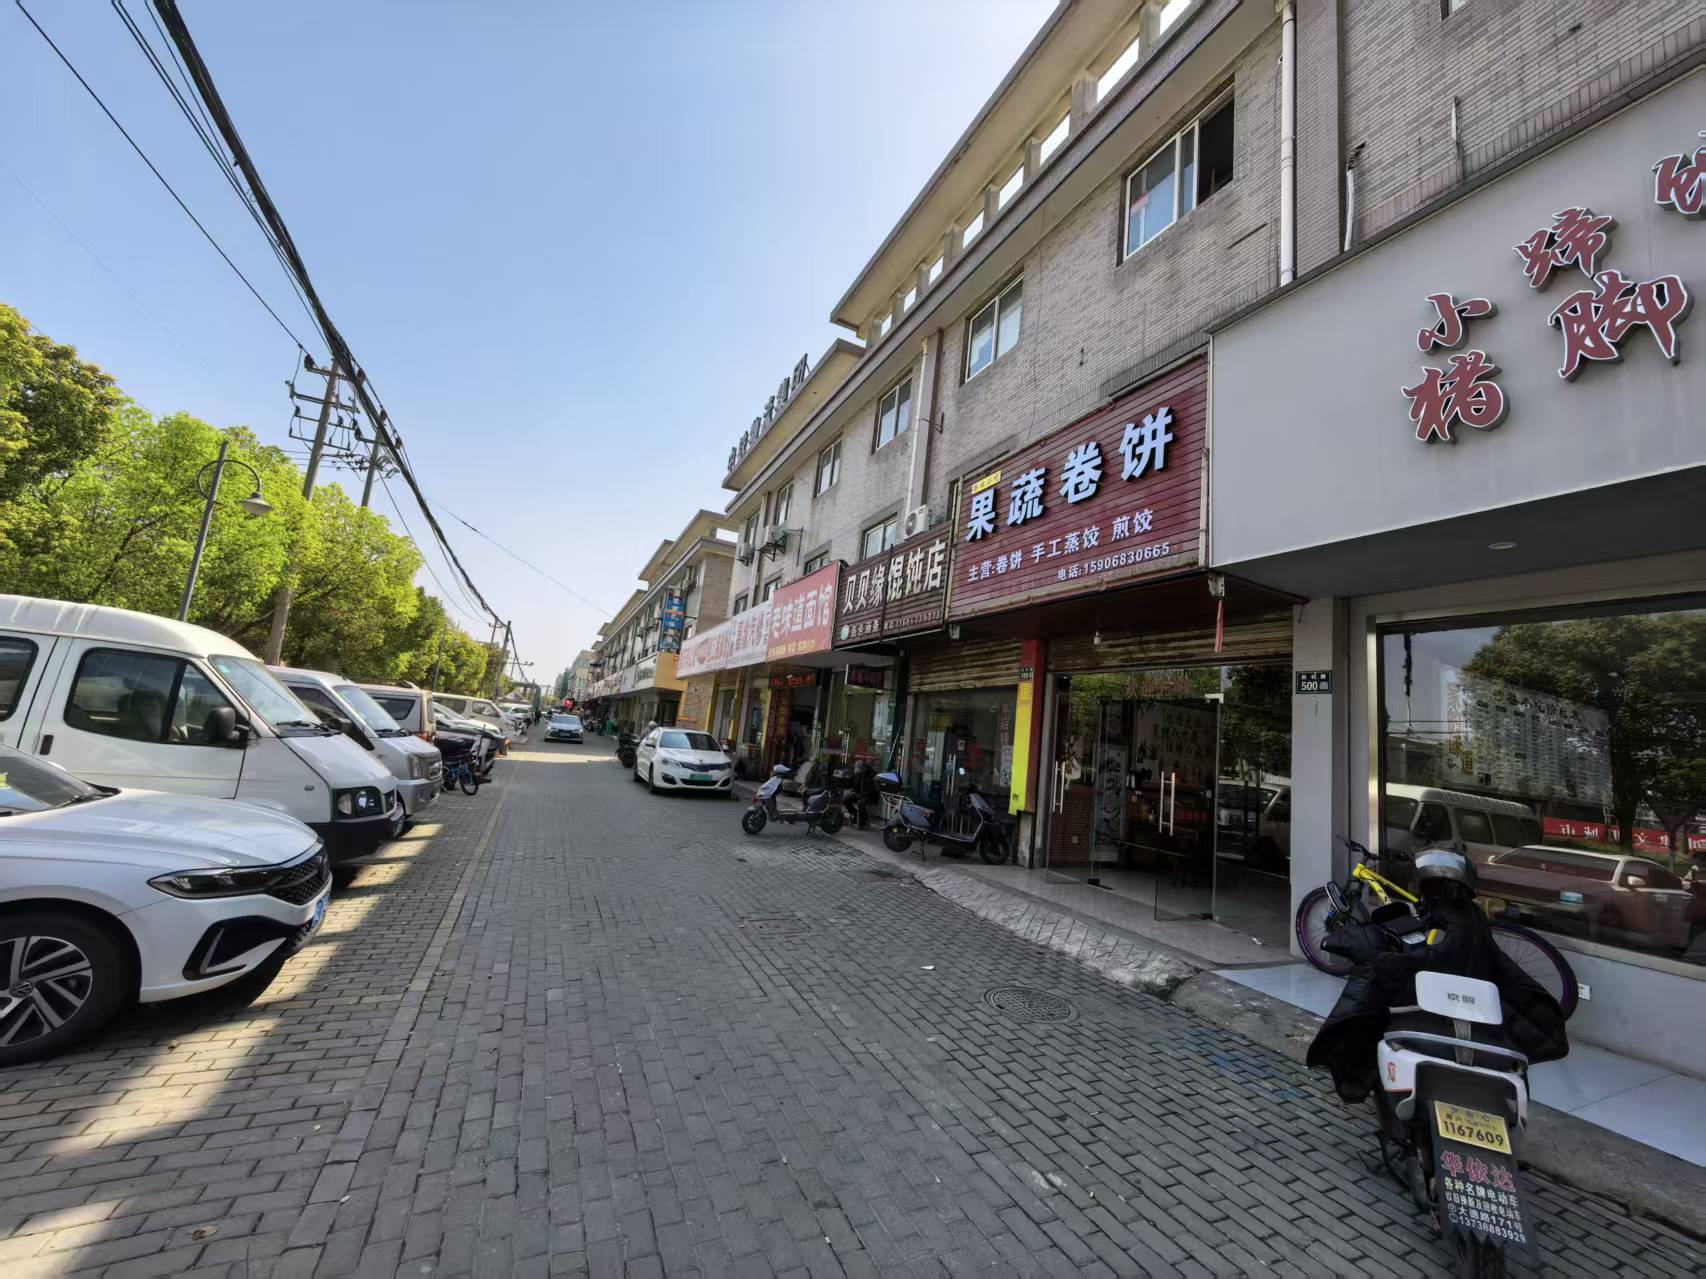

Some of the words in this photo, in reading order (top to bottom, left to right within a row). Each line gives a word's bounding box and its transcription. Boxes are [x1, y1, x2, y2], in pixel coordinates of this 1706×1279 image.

[966, 407, 1173, 542] 果蔬卷饼
[1031, 525, 1100, 564] 手工蒸饺
[1112, 508, 1153, 542] 煎饺
[843, 539, 947, 615] 贝贝缘馄饨店
[1443, 1121, 1504, 1146] 1167609
